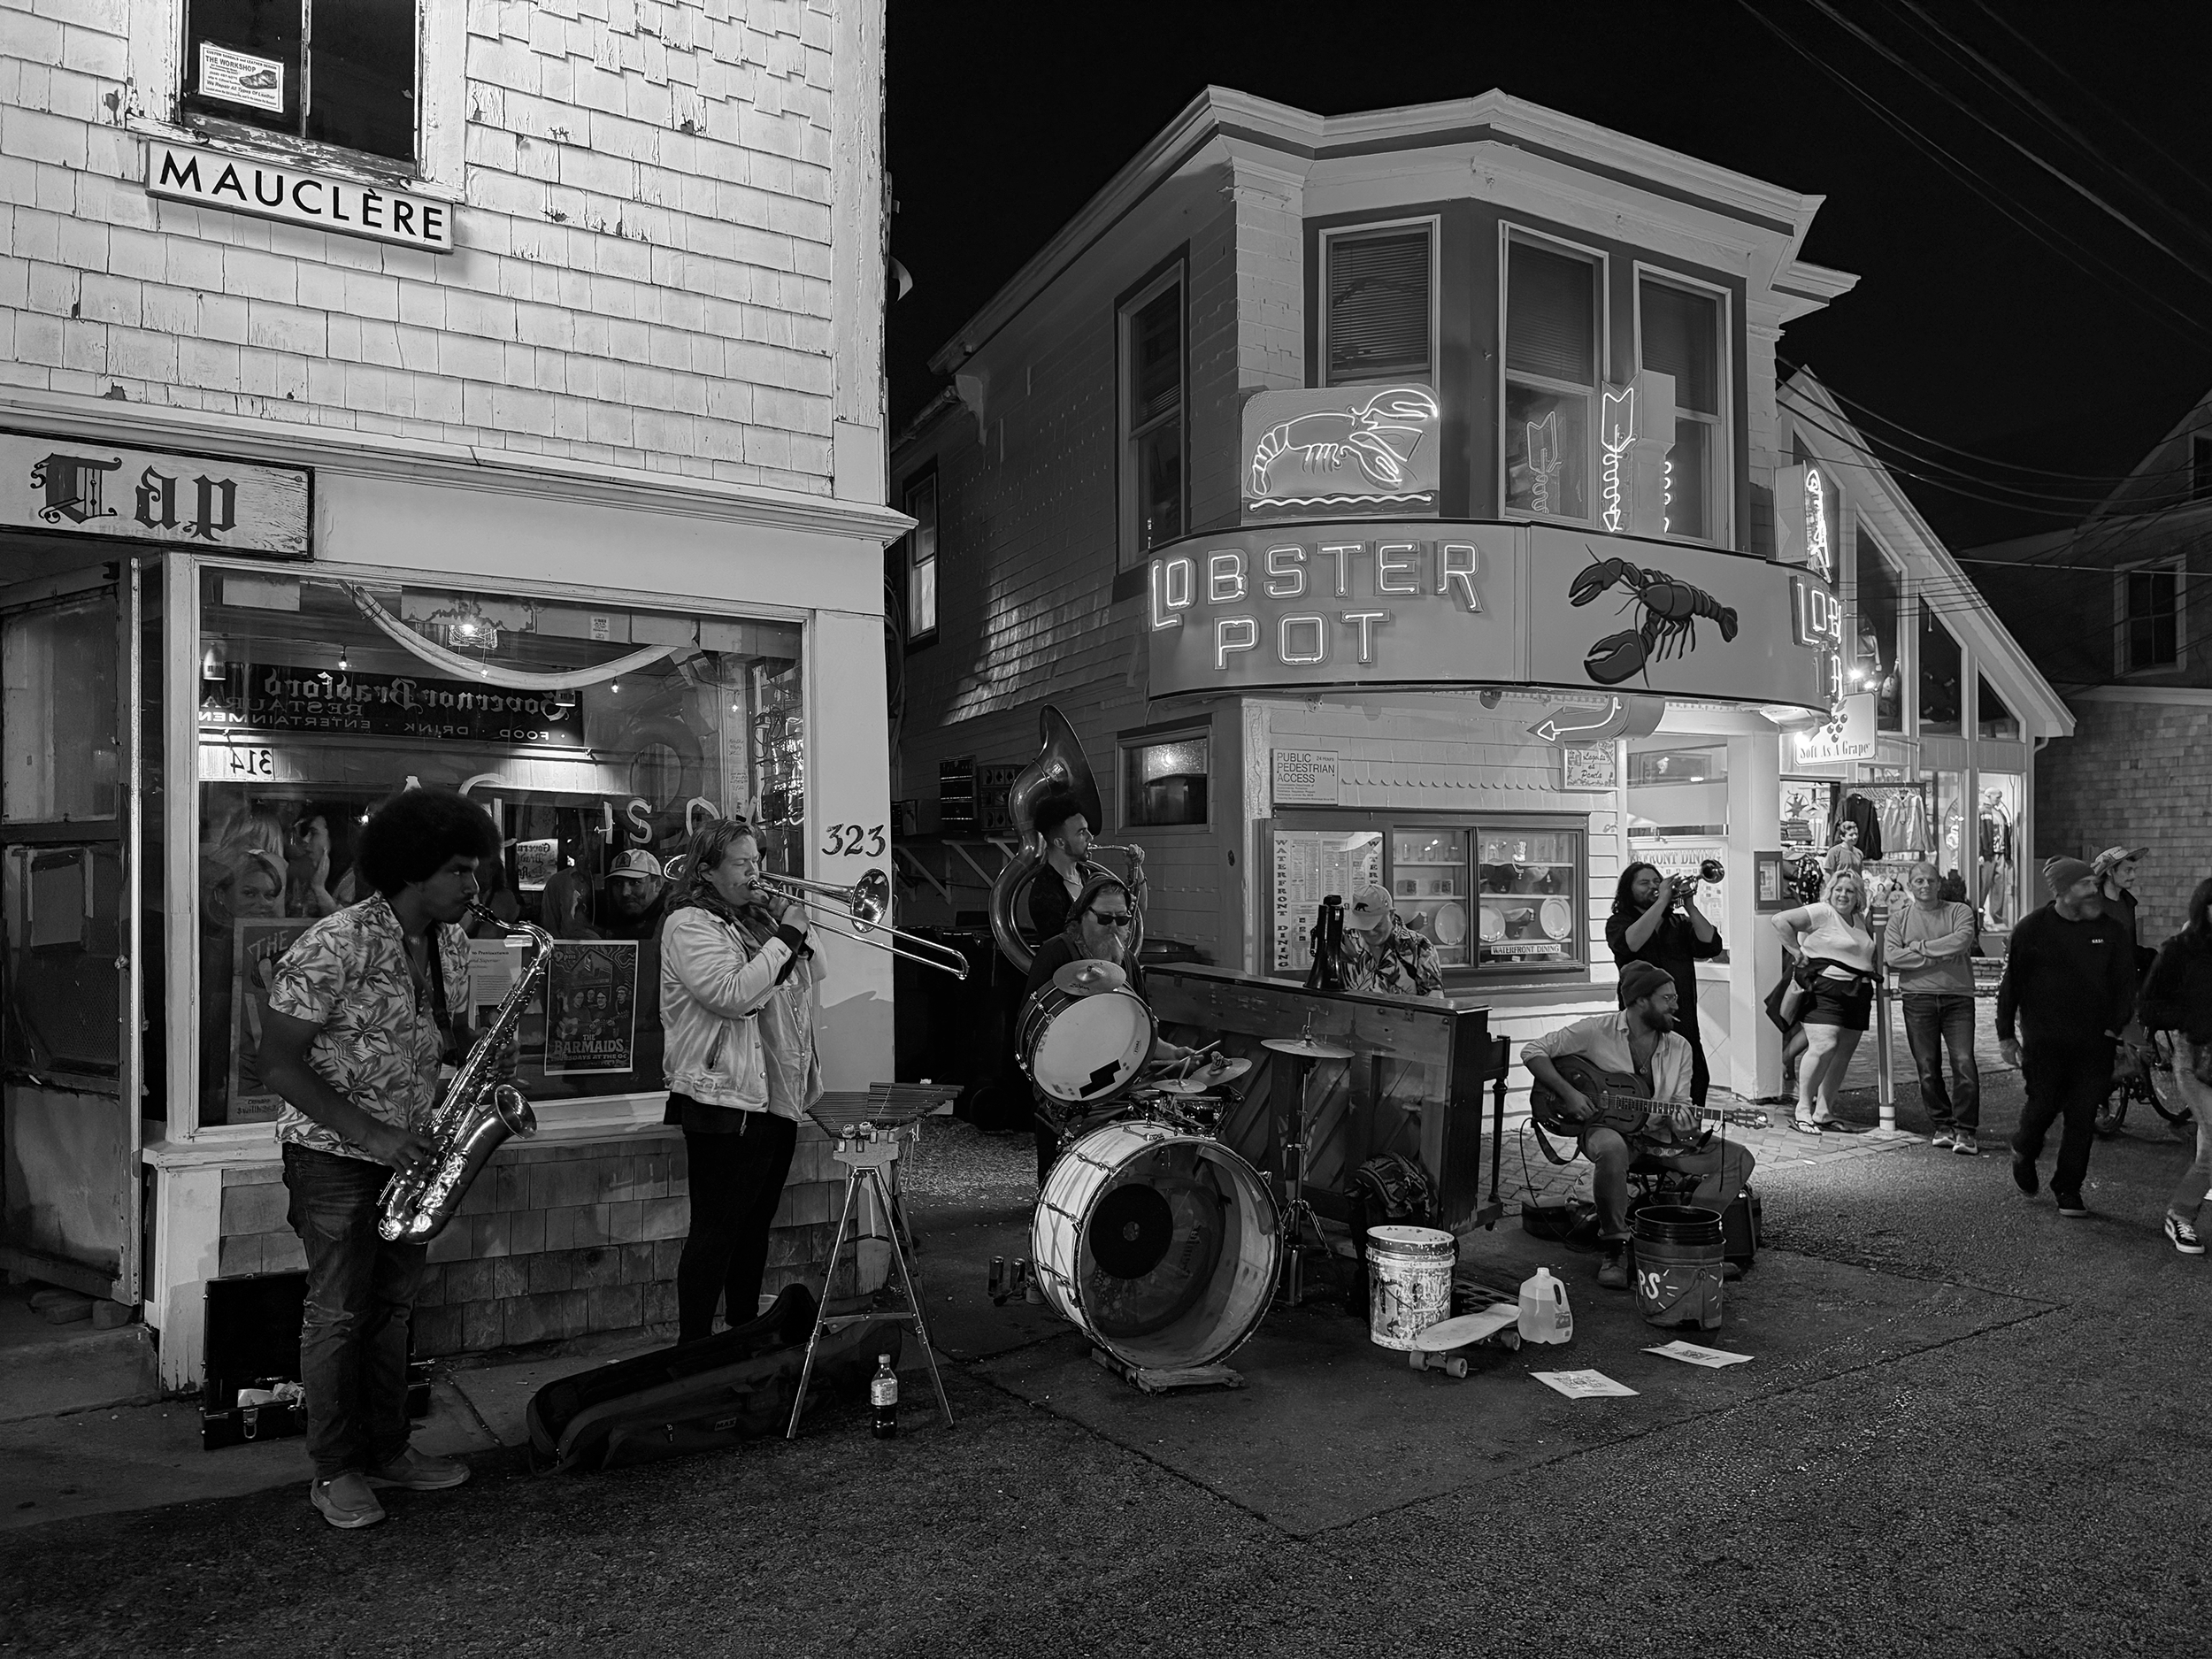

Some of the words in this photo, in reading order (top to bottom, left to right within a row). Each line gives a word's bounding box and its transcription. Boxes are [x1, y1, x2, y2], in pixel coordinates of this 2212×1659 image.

[205, 55, 219, 64] THE
[219, 58, 257, 73] WORKSHOP
[159, 150, 442, 242] MAUCLÈRE
[30, 453, 238, 541] Tap
[1151, 540, 1482, 632] LOBSTER
[1215, 608, 1391, 670] POT
[1277, 752, 1311, 763] PUBLIC
[1842, 741, 1869, 757] Grape
[1277, 763, 1335, 773] PEDESTRIAN
[1277, 772, 1316, 783] ACCESS
[821, 823, 886, 856] 323
[1275, 840, 1288, 917] WATERFRONT
[1278, 926, 1289, 967] DINING
[553, 1038, 625, 1054] BARMAIDS
